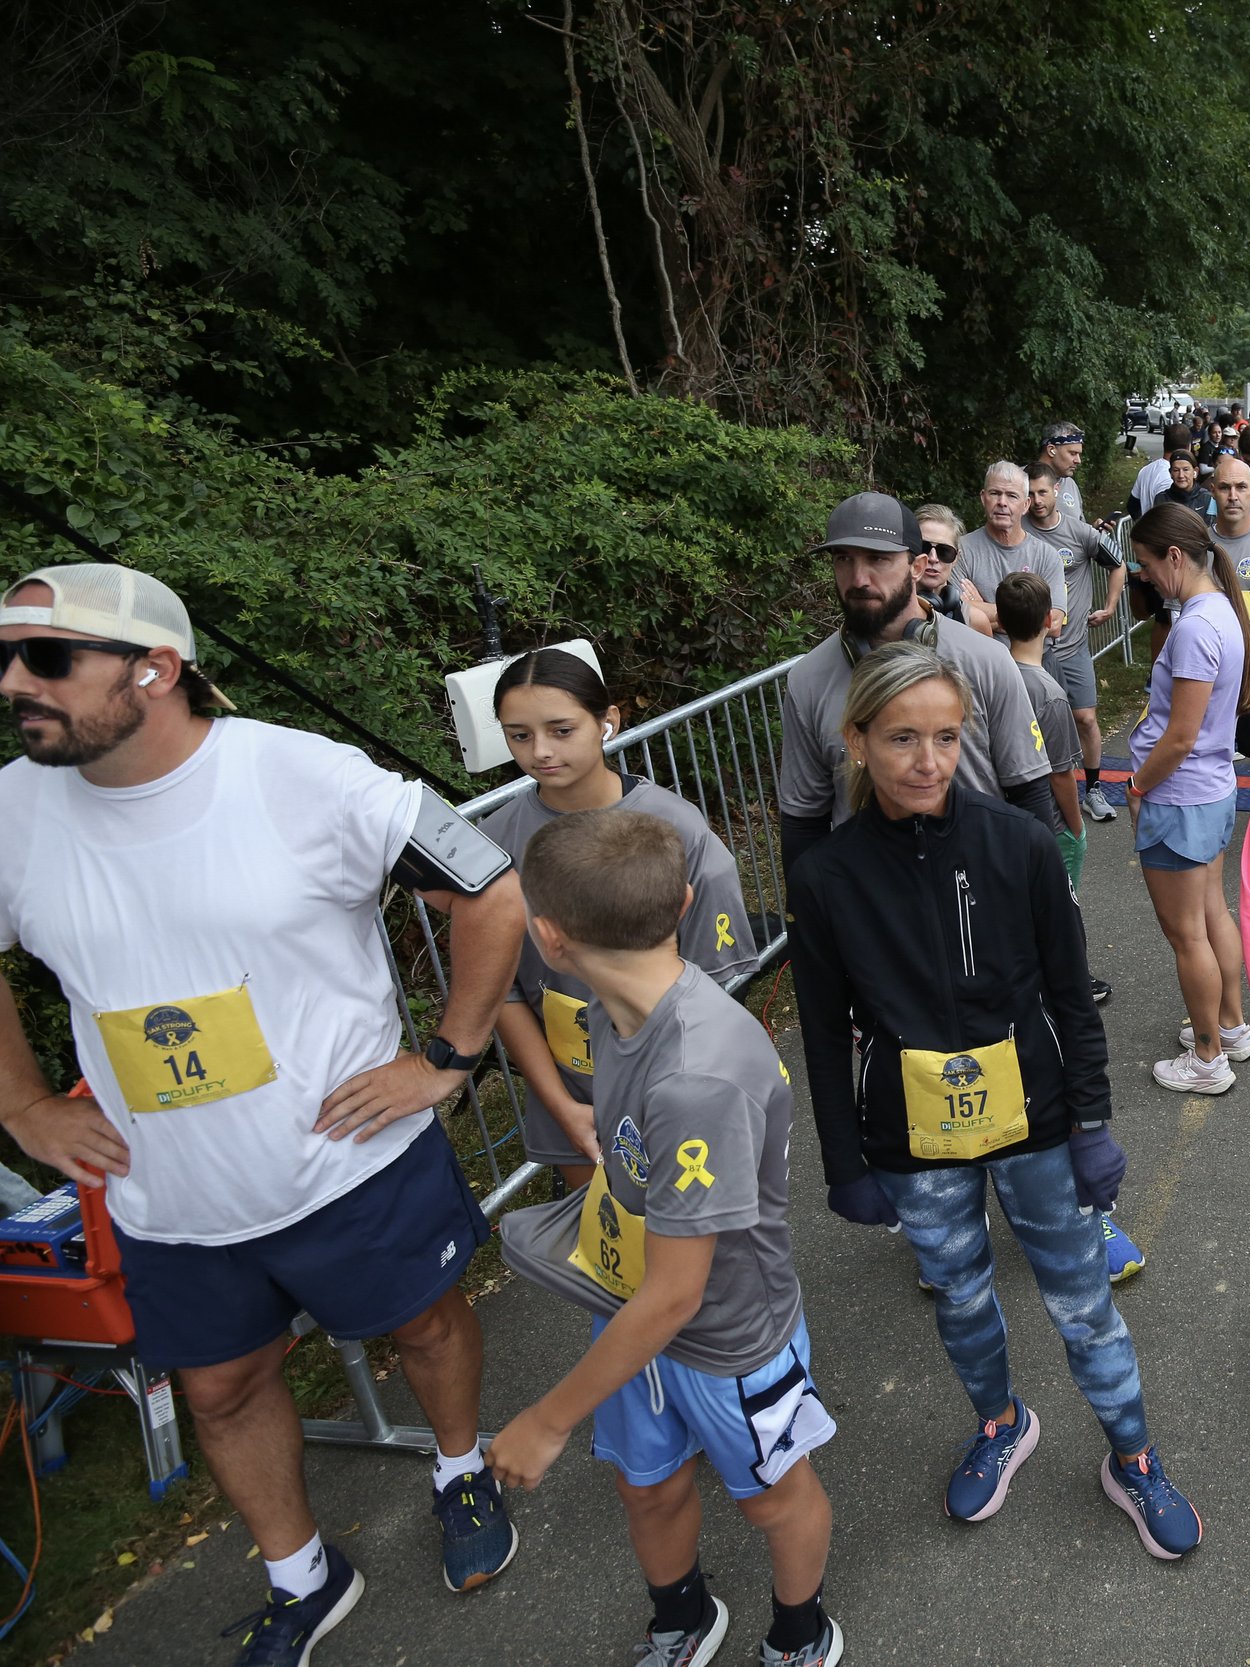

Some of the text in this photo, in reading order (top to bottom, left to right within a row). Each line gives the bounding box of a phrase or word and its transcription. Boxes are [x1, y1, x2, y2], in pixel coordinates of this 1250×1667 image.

[161, 1022, 193, 1030] STRONG
[163, 1050, 207, 1085] 14
[171, 1079, 226, 1099] DUFFY
[944, 1089, 988, 1119] 157
[952, 1115, 994, 1129] DUFFY
[689, 1164, 701, 1172] 87
[601, 1238, 624, 1280] 62
[601, 1271, 637, 1295] DUFFY
